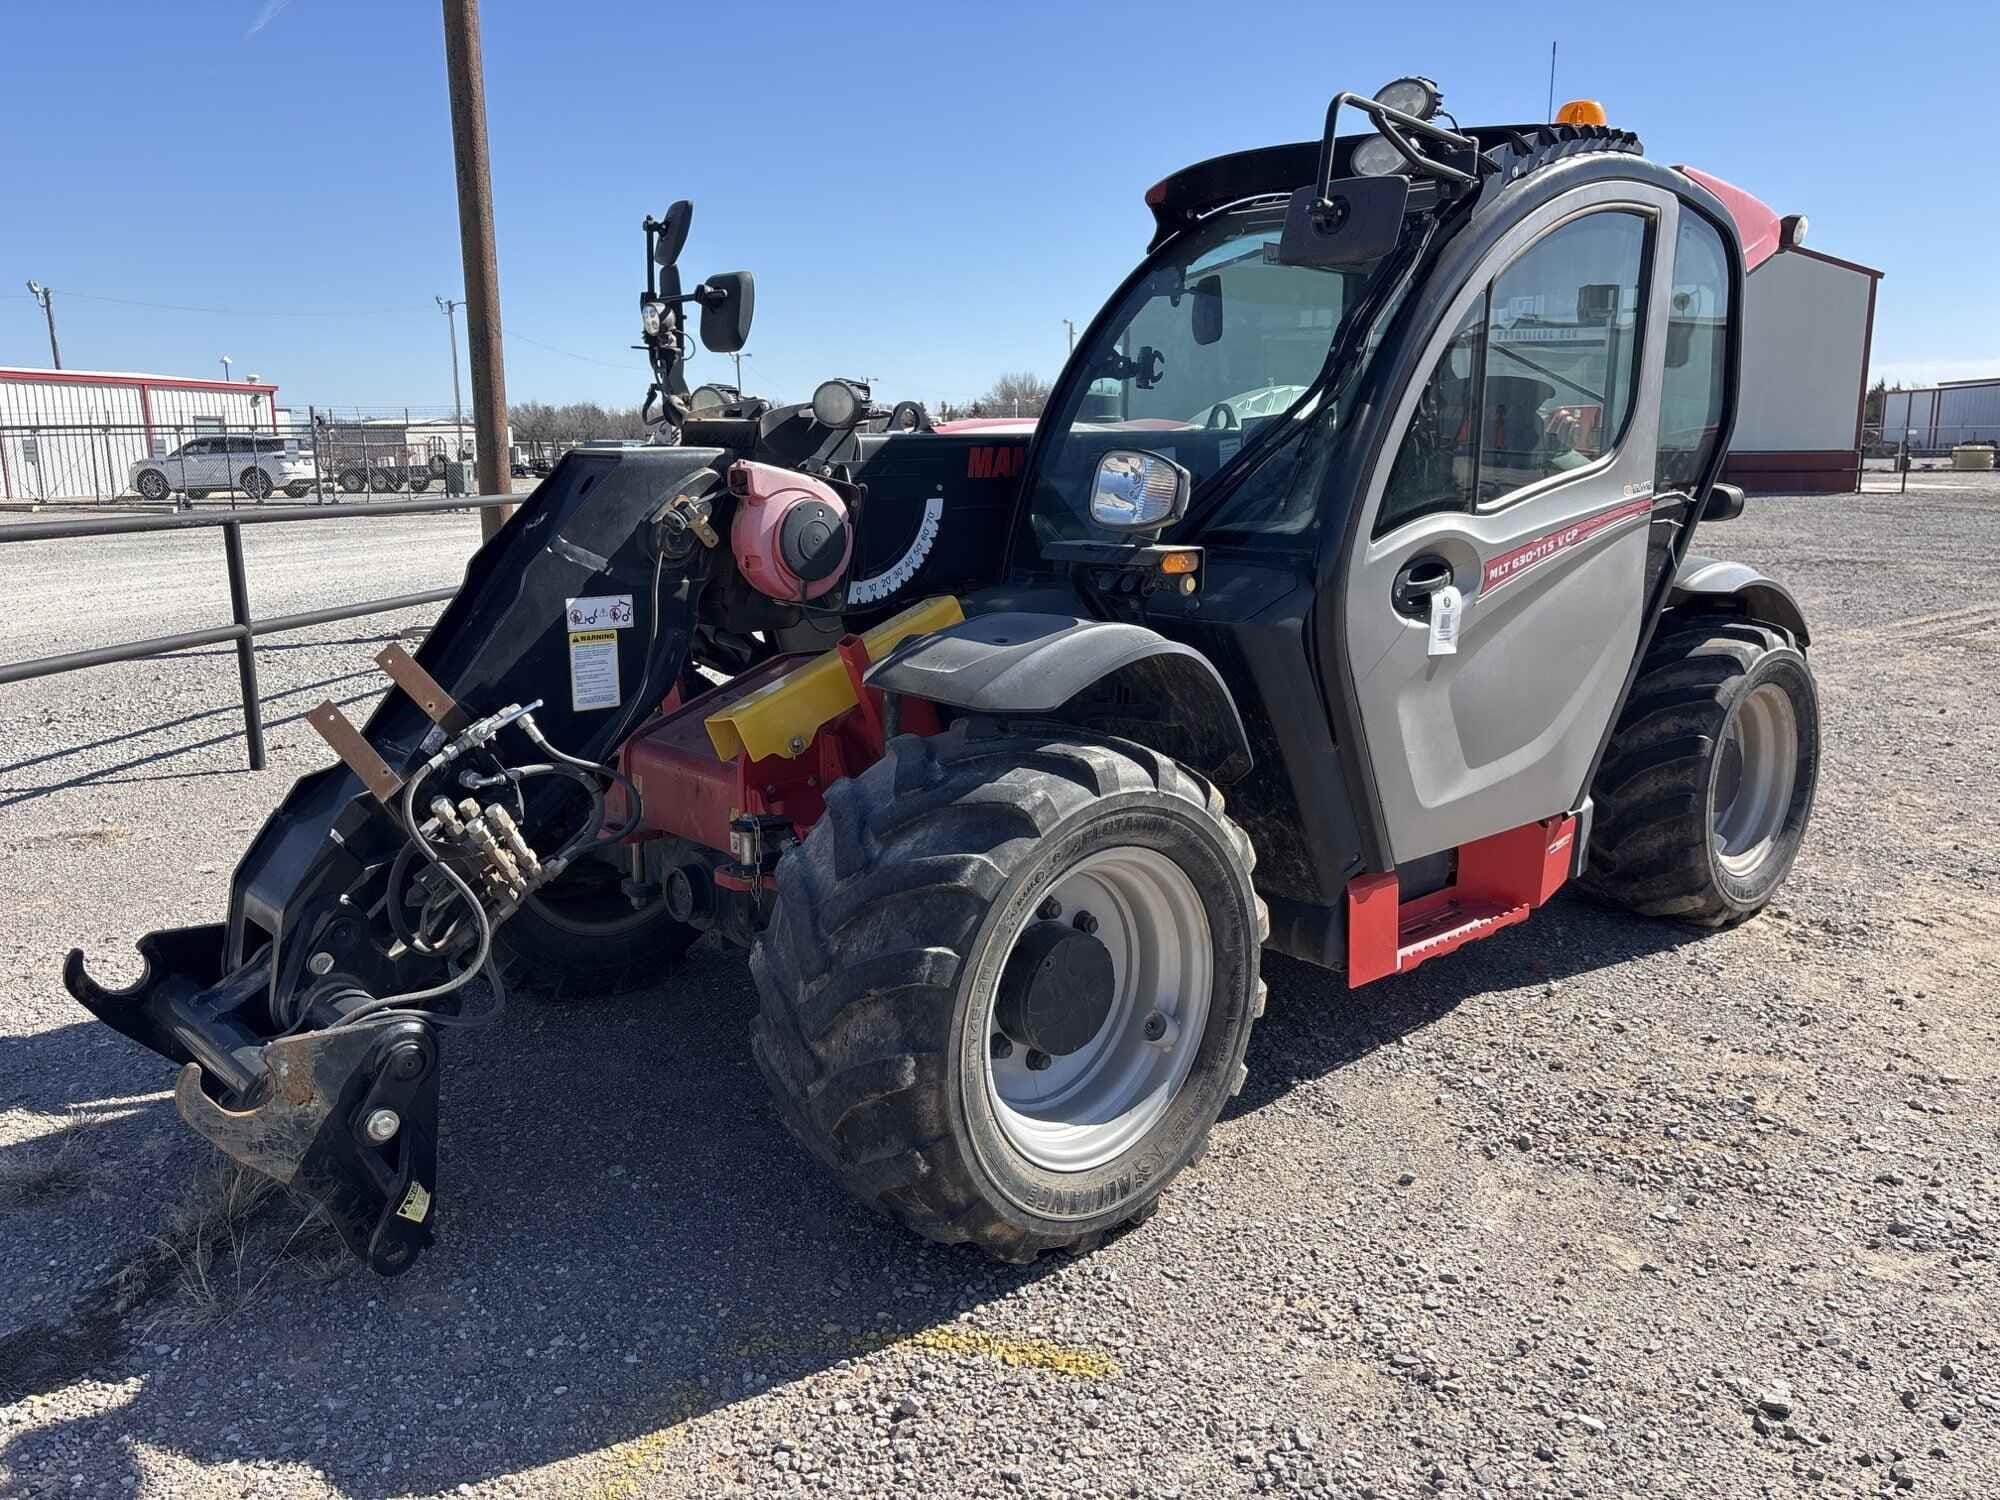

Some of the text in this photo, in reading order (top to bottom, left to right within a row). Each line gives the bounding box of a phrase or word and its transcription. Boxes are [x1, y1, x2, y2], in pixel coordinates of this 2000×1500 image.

[1489, 560, 1511, 581] MLT
[1511, 540, 1555, 569] 630-115
[580, 633, 615, 642] WARNING
[1023, 1172, 1132, 1215] ALLIANCE
